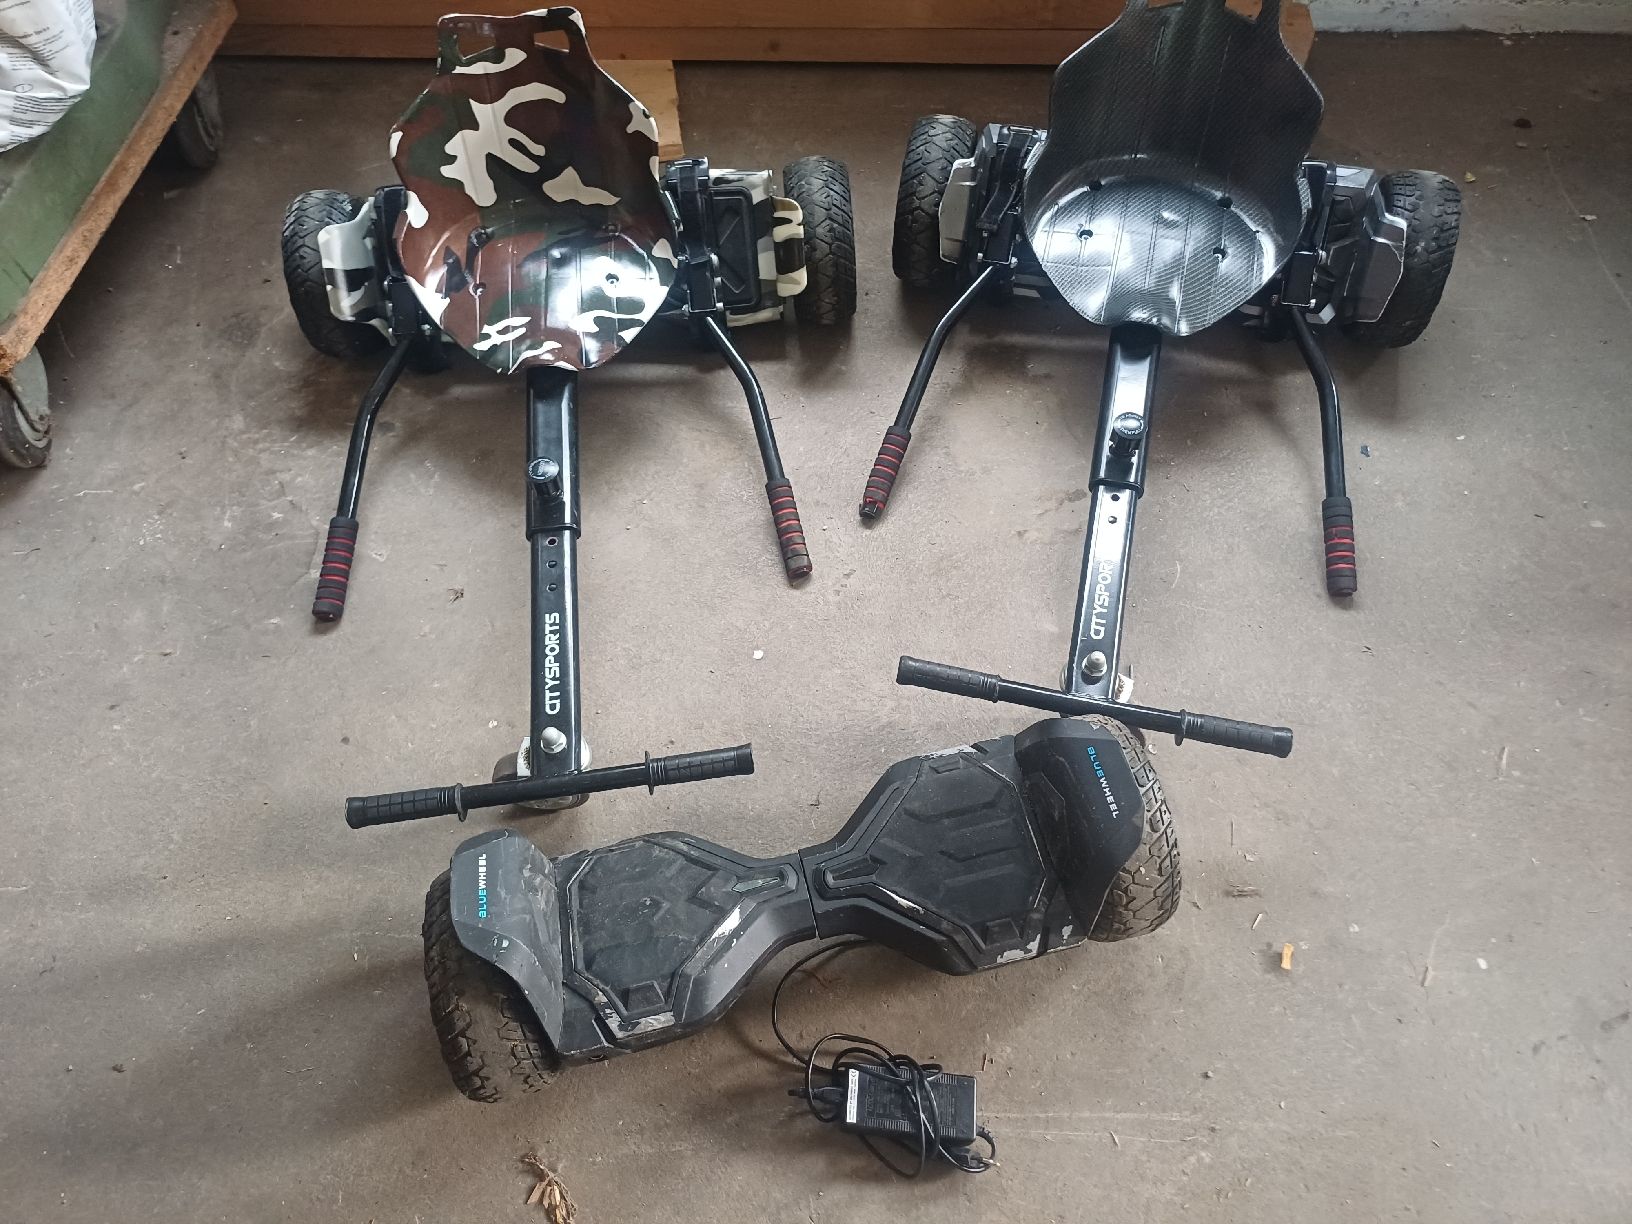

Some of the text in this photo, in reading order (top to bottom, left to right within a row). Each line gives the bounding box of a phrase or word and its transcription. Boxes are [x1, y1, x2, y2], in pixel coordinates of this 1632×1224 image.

[1090, 558, 1113, 640] CITYSPOR
[544, 612, 560, 715] CITYSPORTS
[1087, 746, 1120, 819] BLUEWHEEL
[478, 853, 487, 919] BLUEWHEEL
